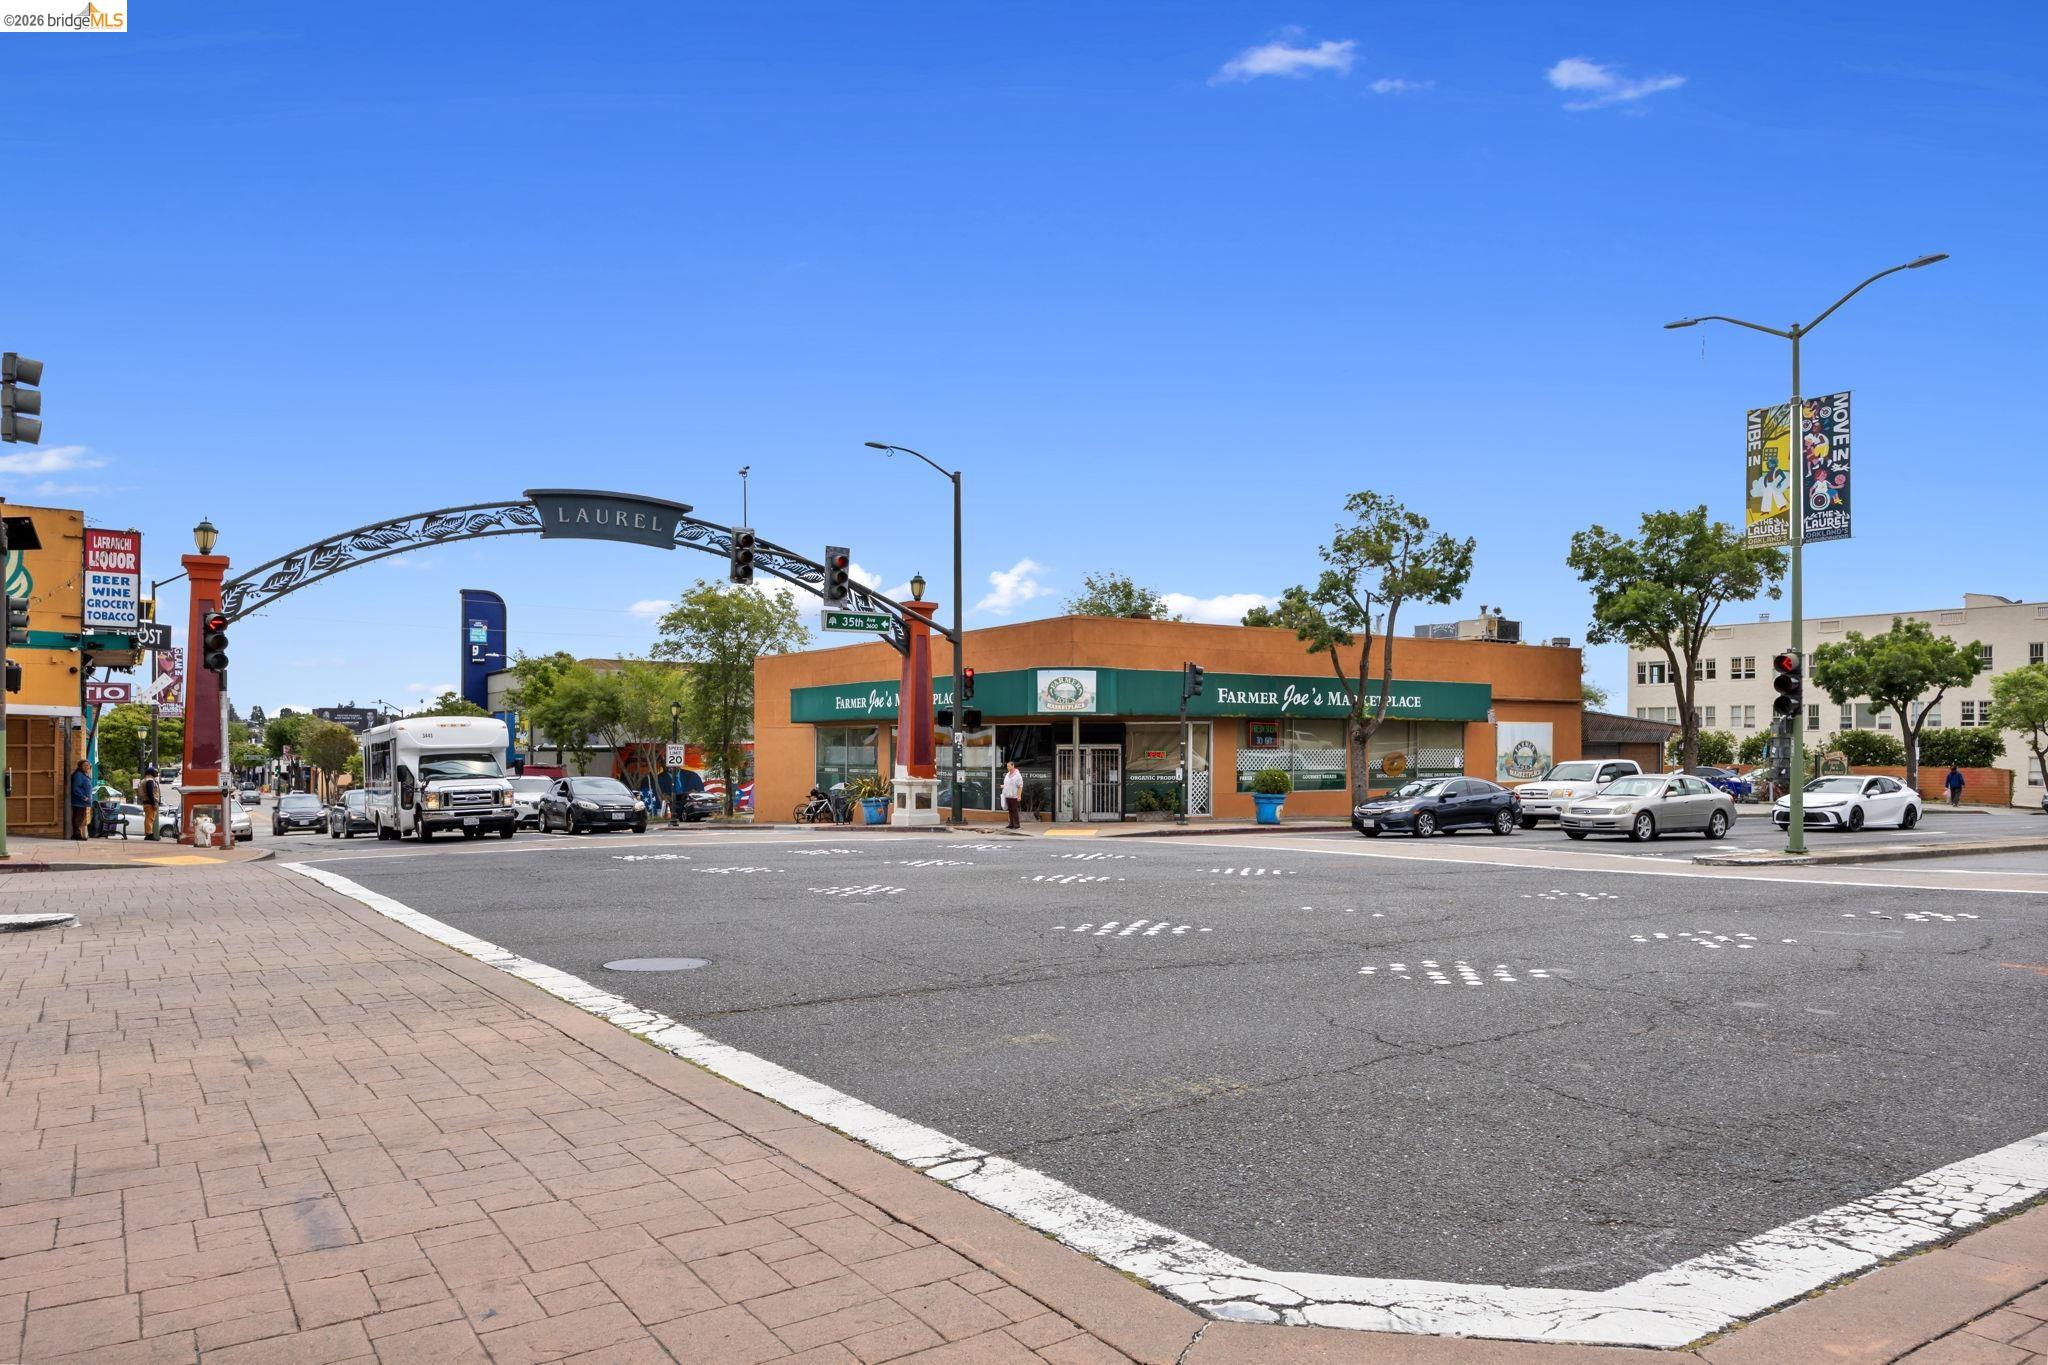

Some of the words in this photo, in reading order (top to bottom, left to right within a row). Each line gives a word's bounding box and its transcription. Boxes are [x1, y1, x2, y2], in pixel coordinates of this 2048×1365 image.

[1833, 393, 1850, 446] MOVE
[1748, 410, 1761, 452] VIBE
[1833, 448, 1849, 462] IN
[1748, 456, 1761, 467] IN
[558, 507, 662, 532] LAUREL
[1818, 510, 1834, 518] THE
[1760, 517, 1774, 526] THE
[1805, 516, 1848, 530] LAUREL
[1748, 523, 1787, 536] LAUREL
[1806, 527, 1848, 538] OAKLAND'S
[93, 536, 132, 551] LAFRANCHI
[1748, 535, 1787, 545] OAKLAND'S
[89, 551, 135, 570] LIQUOR
[92, 575, 130, 586] BEER
[92, 587, 131, 598] WINE
[87, 599, 135, 610] GROCERY
[87, 611, 135, 622] TOBACCO
[841, 617, 863, 628] 35th
[835, 696, 867, 709] FARMER
[868, 689, 892, 714] Joe's
[1217, 688, 1279, 704] FARMER
[1281, 684, 1323, 711] Joe's
[669, 756, 683, 764] 20
